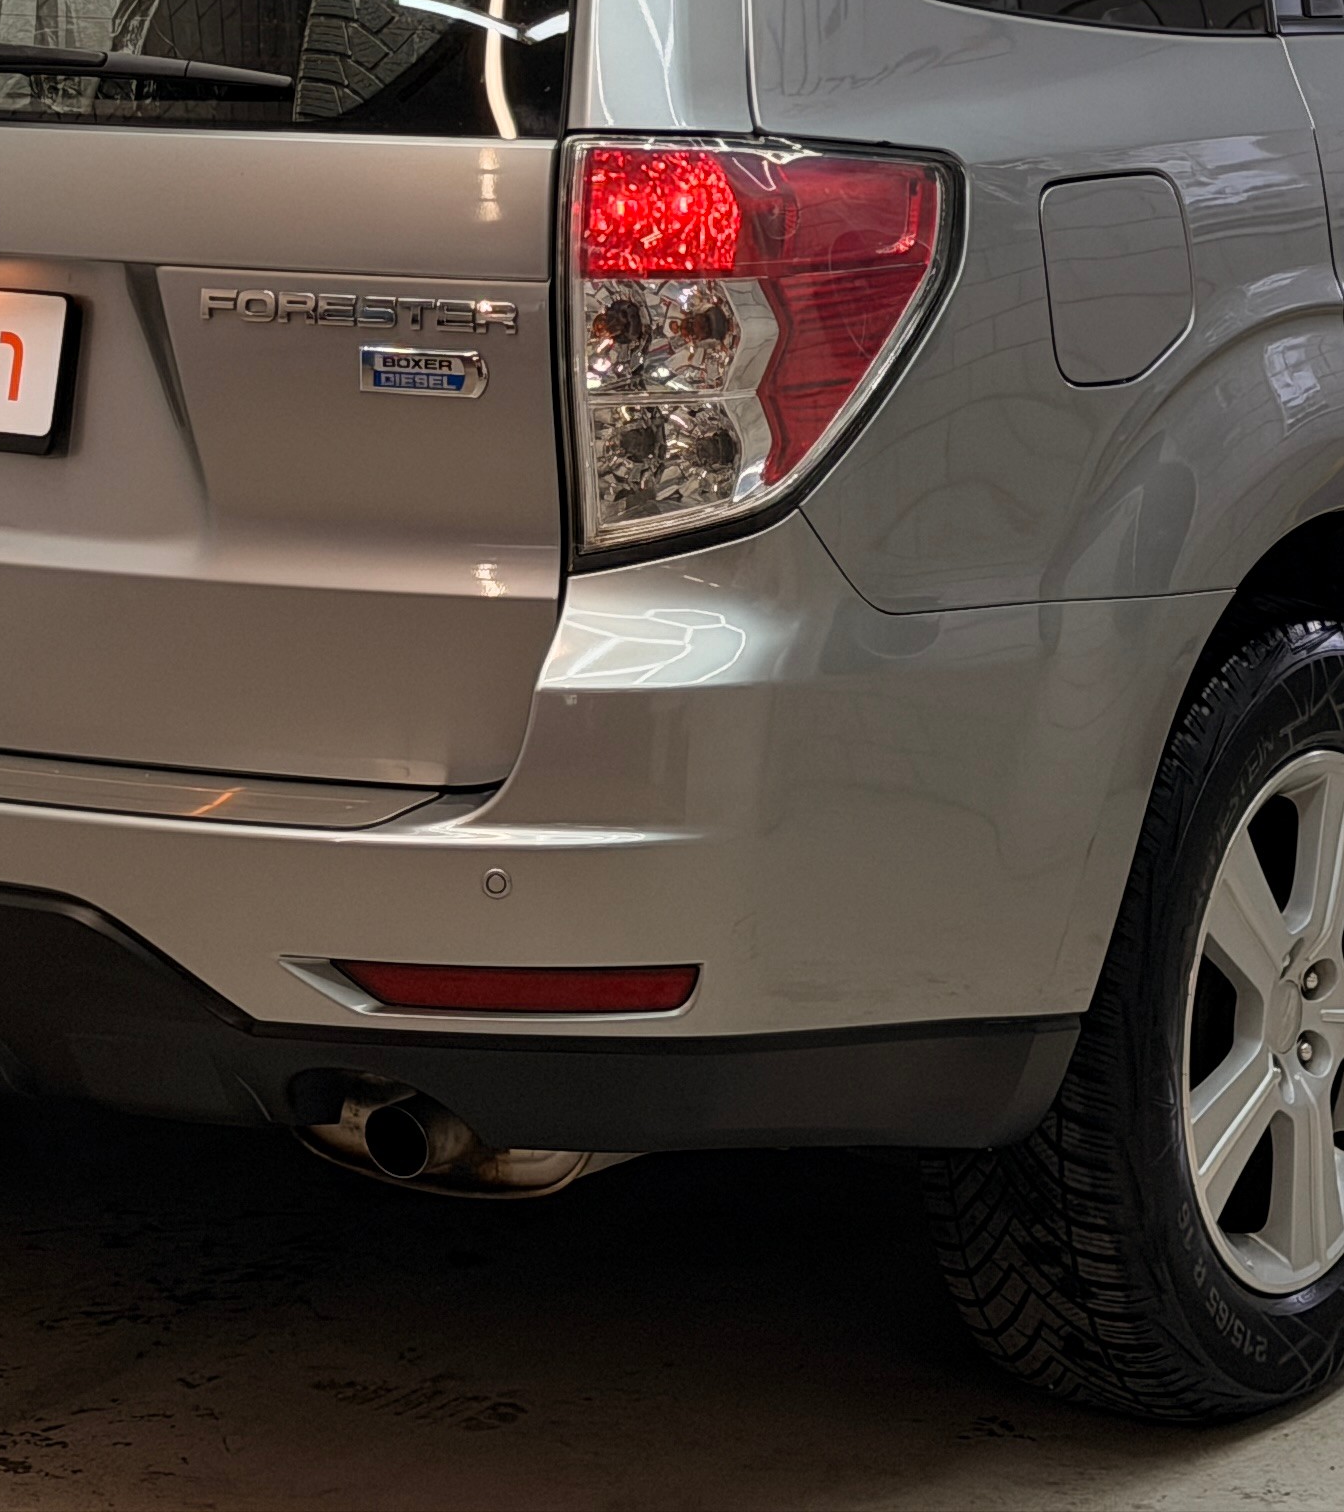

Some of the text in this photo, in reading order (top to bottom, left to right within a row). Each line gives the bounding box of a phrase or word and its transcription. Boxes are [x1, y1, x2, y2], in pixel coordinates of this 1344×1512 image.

[199, 287, 518, 335] FORESTER
[0, 330, 24, 402] 1
[380, 372, 458, 390] DIESEL
[382, 356, 453, 372] BOXER
[1205, 1285, 1269, 1363] 215/65
